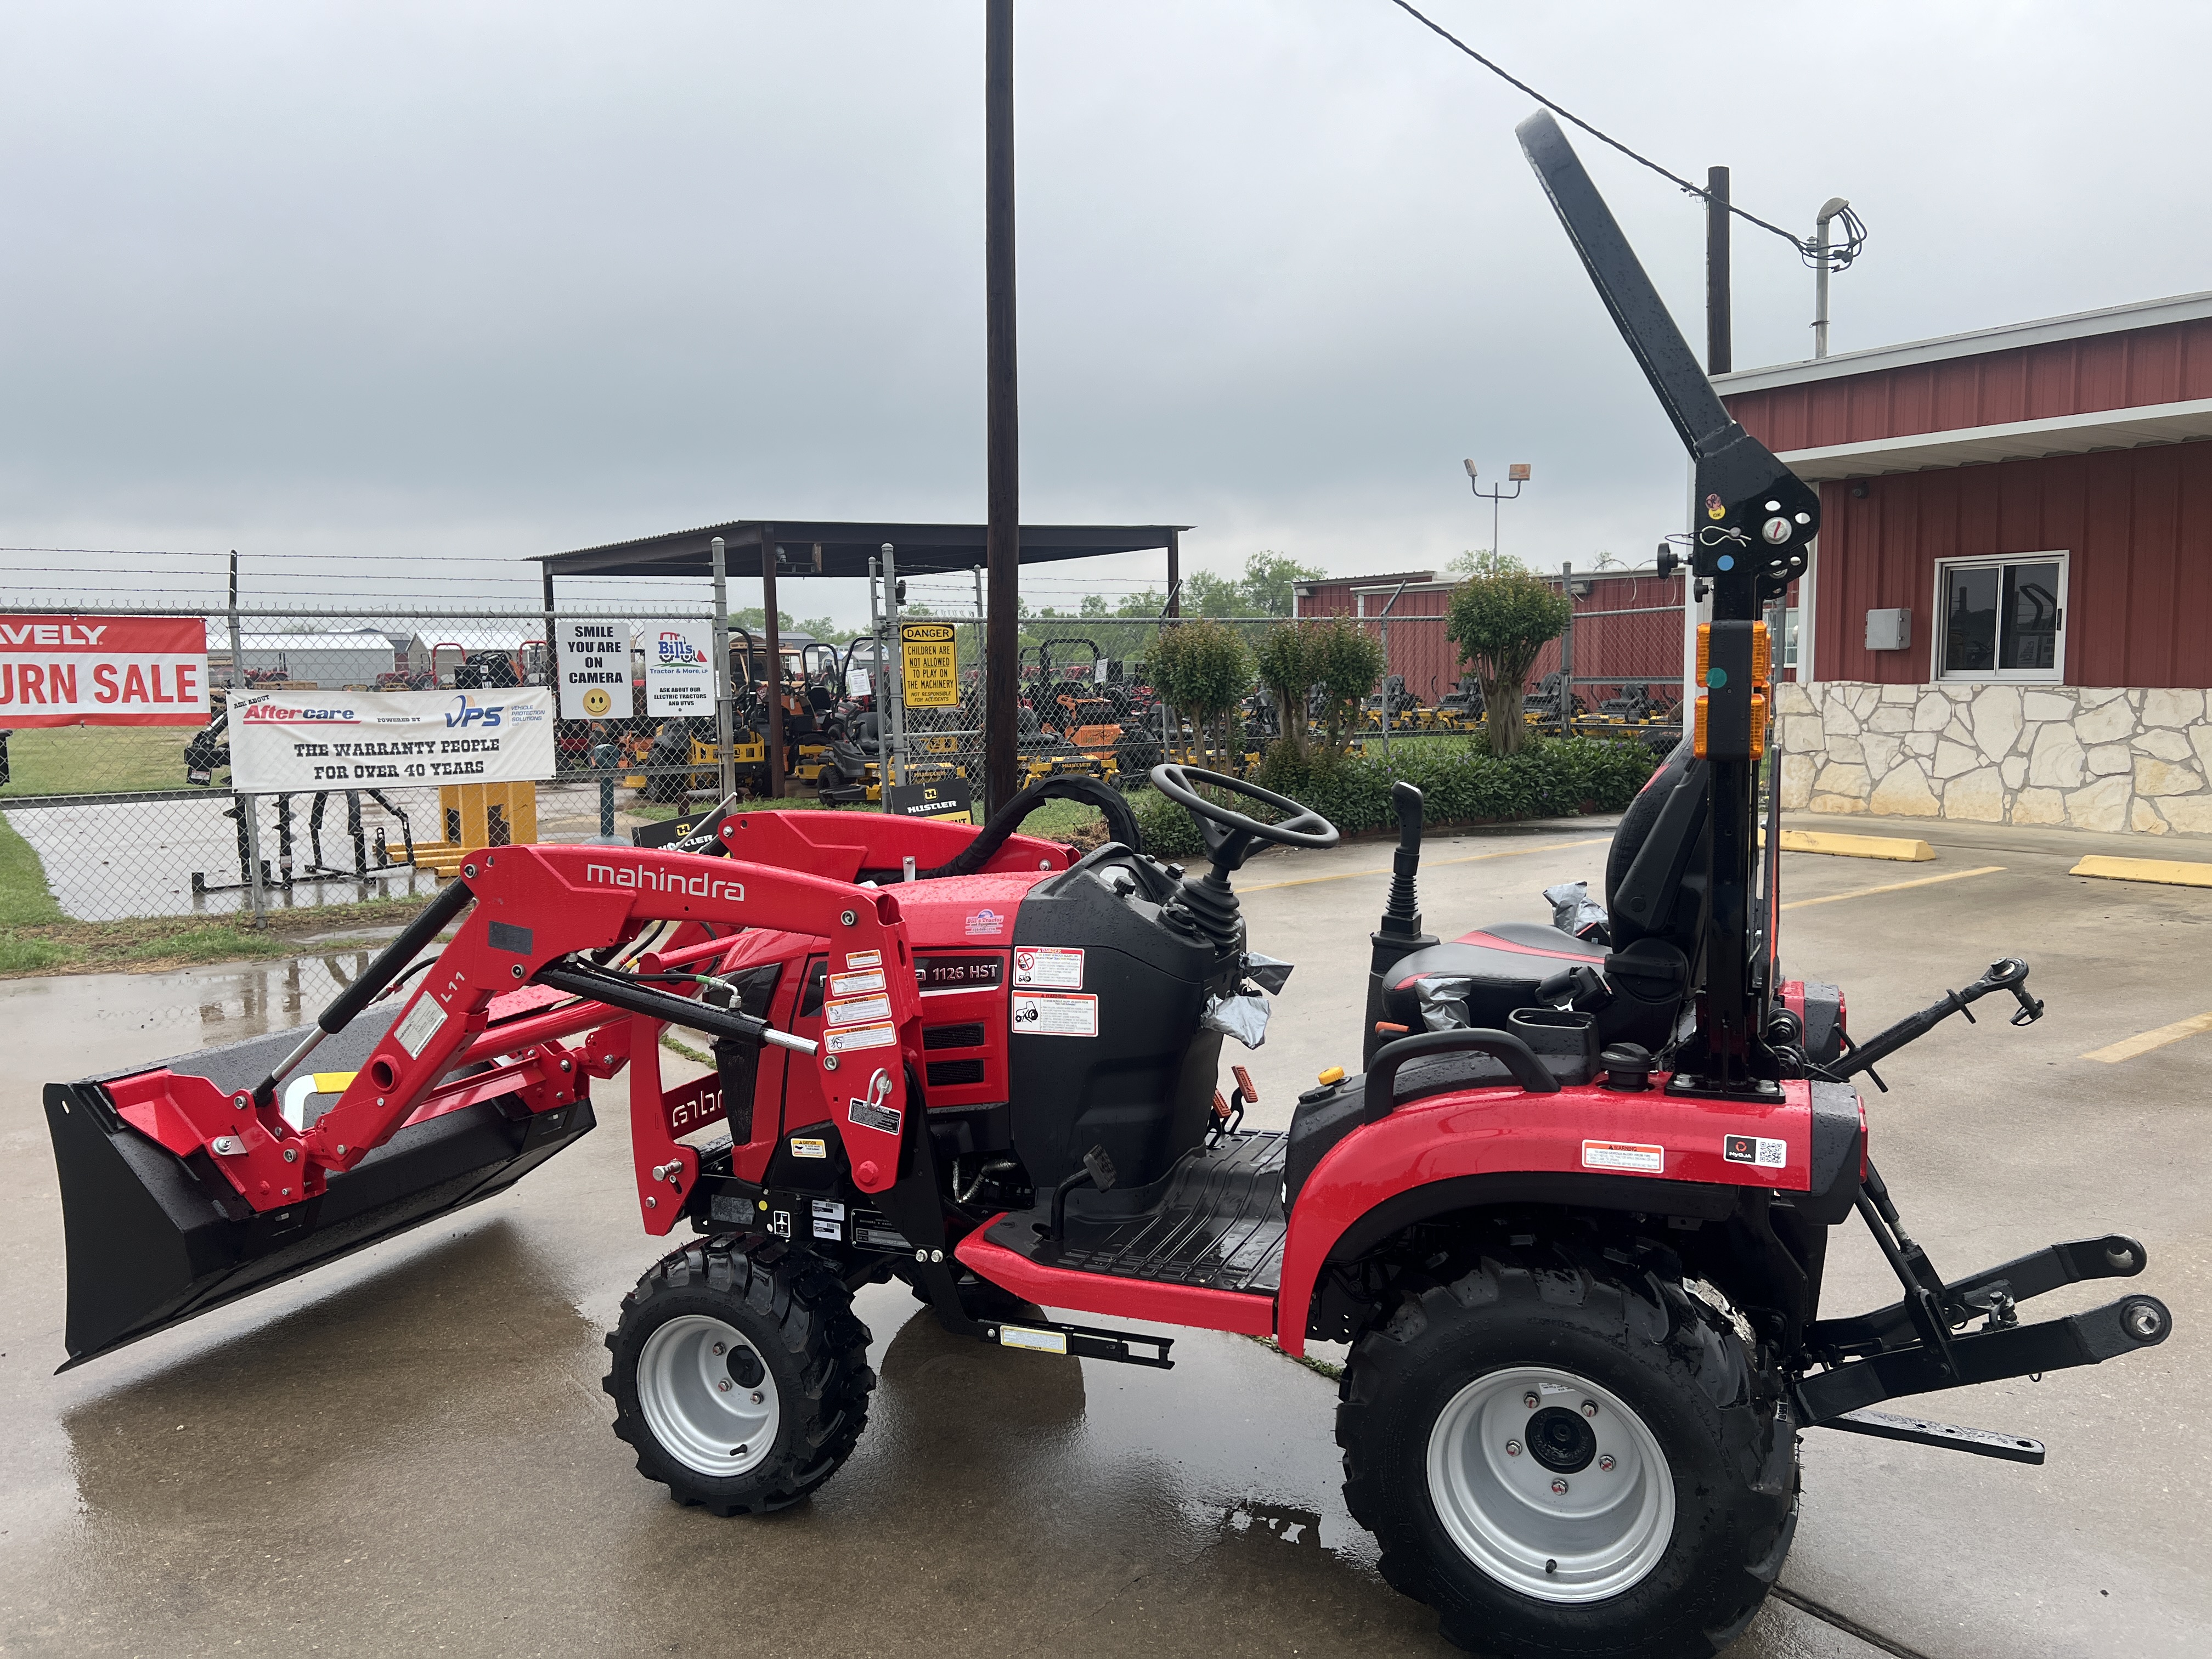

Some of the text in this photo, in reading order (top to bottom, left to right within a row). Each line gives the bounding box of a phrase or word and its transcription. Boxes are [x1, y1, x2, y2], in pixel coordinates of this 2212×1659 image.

[574, 626, 614, 637] SMILE
[907, 629, 950, 637] DANGER
[567, 641, 622, 653] YOU ARE
[907, 646, 951, 656] CHILDREN ARE
[585, 657, 603, 668] ON
[910, 657, 950, 667] NOT ALLOWED
[569, 672, 623, 684] CAMERA
[913, 669, 948, 678] TO PLAY ON
[93, 663, 199, 704] SALE
[907, 680, 953, 689] THE MACHINERY
[248, 695, 269, 704] ABOUT
[243, 705, 354, 719] Aftercare
[445, 696, 504, 727] VPS
[294, 738, 500, 757] THE WARRANTY PEOPLE
[314, 761, 484, 780] FOR OVER 40 YEARS
[907, 800, 957, 814] HUSTLER
[586, 864, 745, 901] mahindra
[933, 967, 964, 981] 1126
[969, 964, 997, 979] HST
